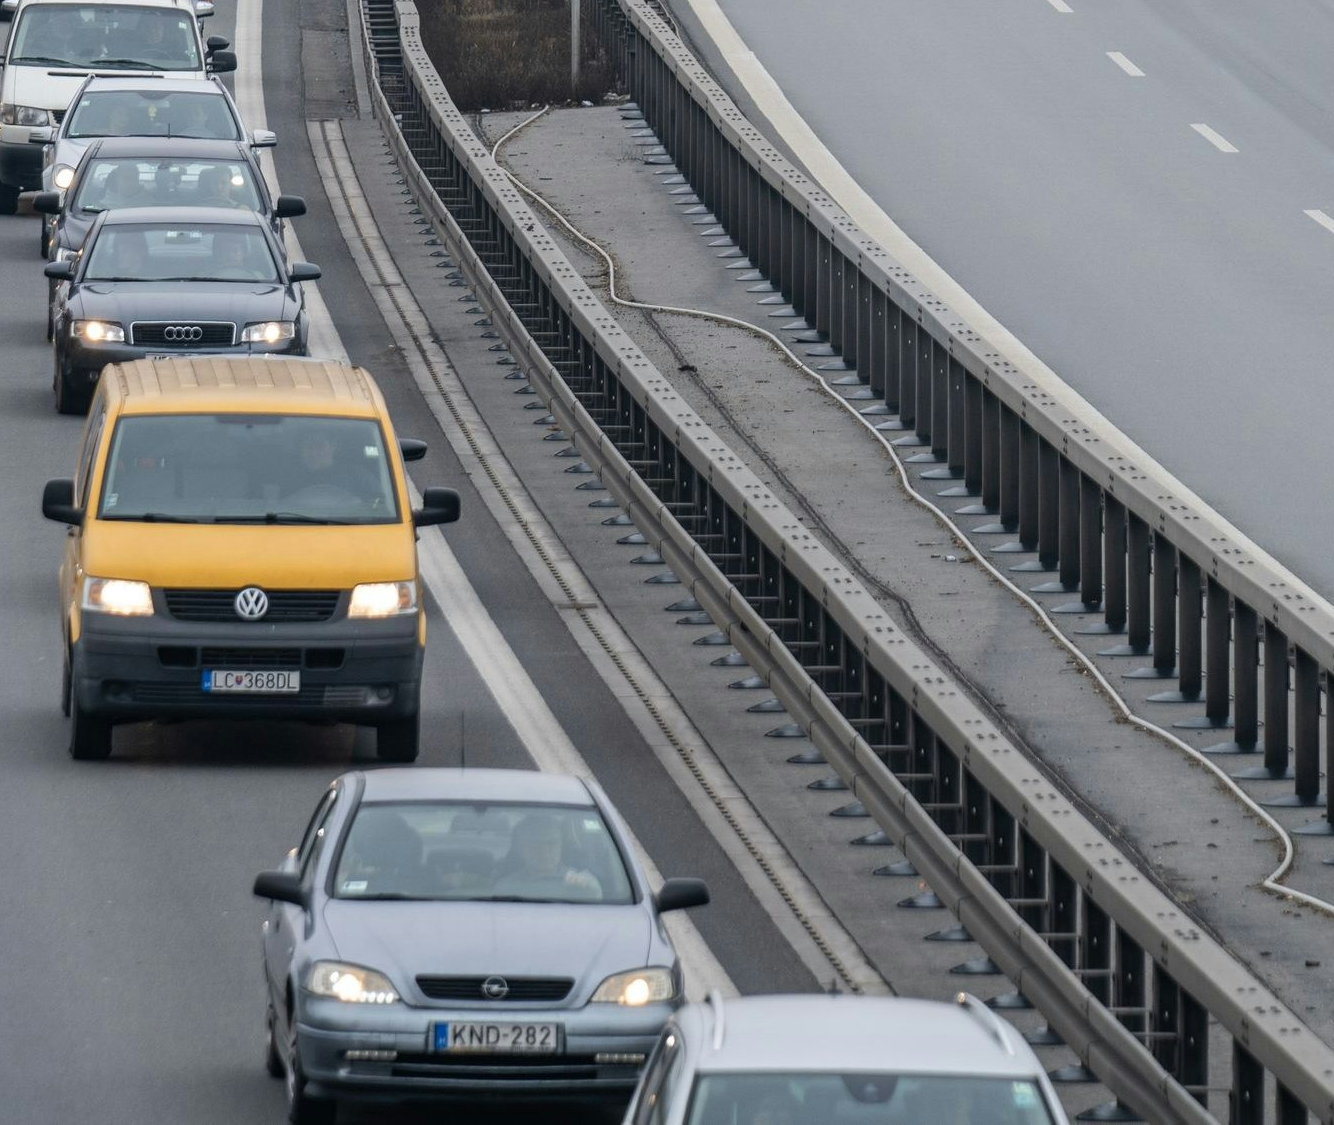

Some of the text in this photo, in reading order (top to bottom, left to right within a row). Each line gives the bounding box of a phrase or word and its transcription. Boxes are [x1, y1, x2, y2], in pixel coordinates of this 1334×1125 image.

[214, 672, 234, 688] LC
[244, 673, 297, 689] 368DL
[452, 1024, 551, 1046] KND-282
